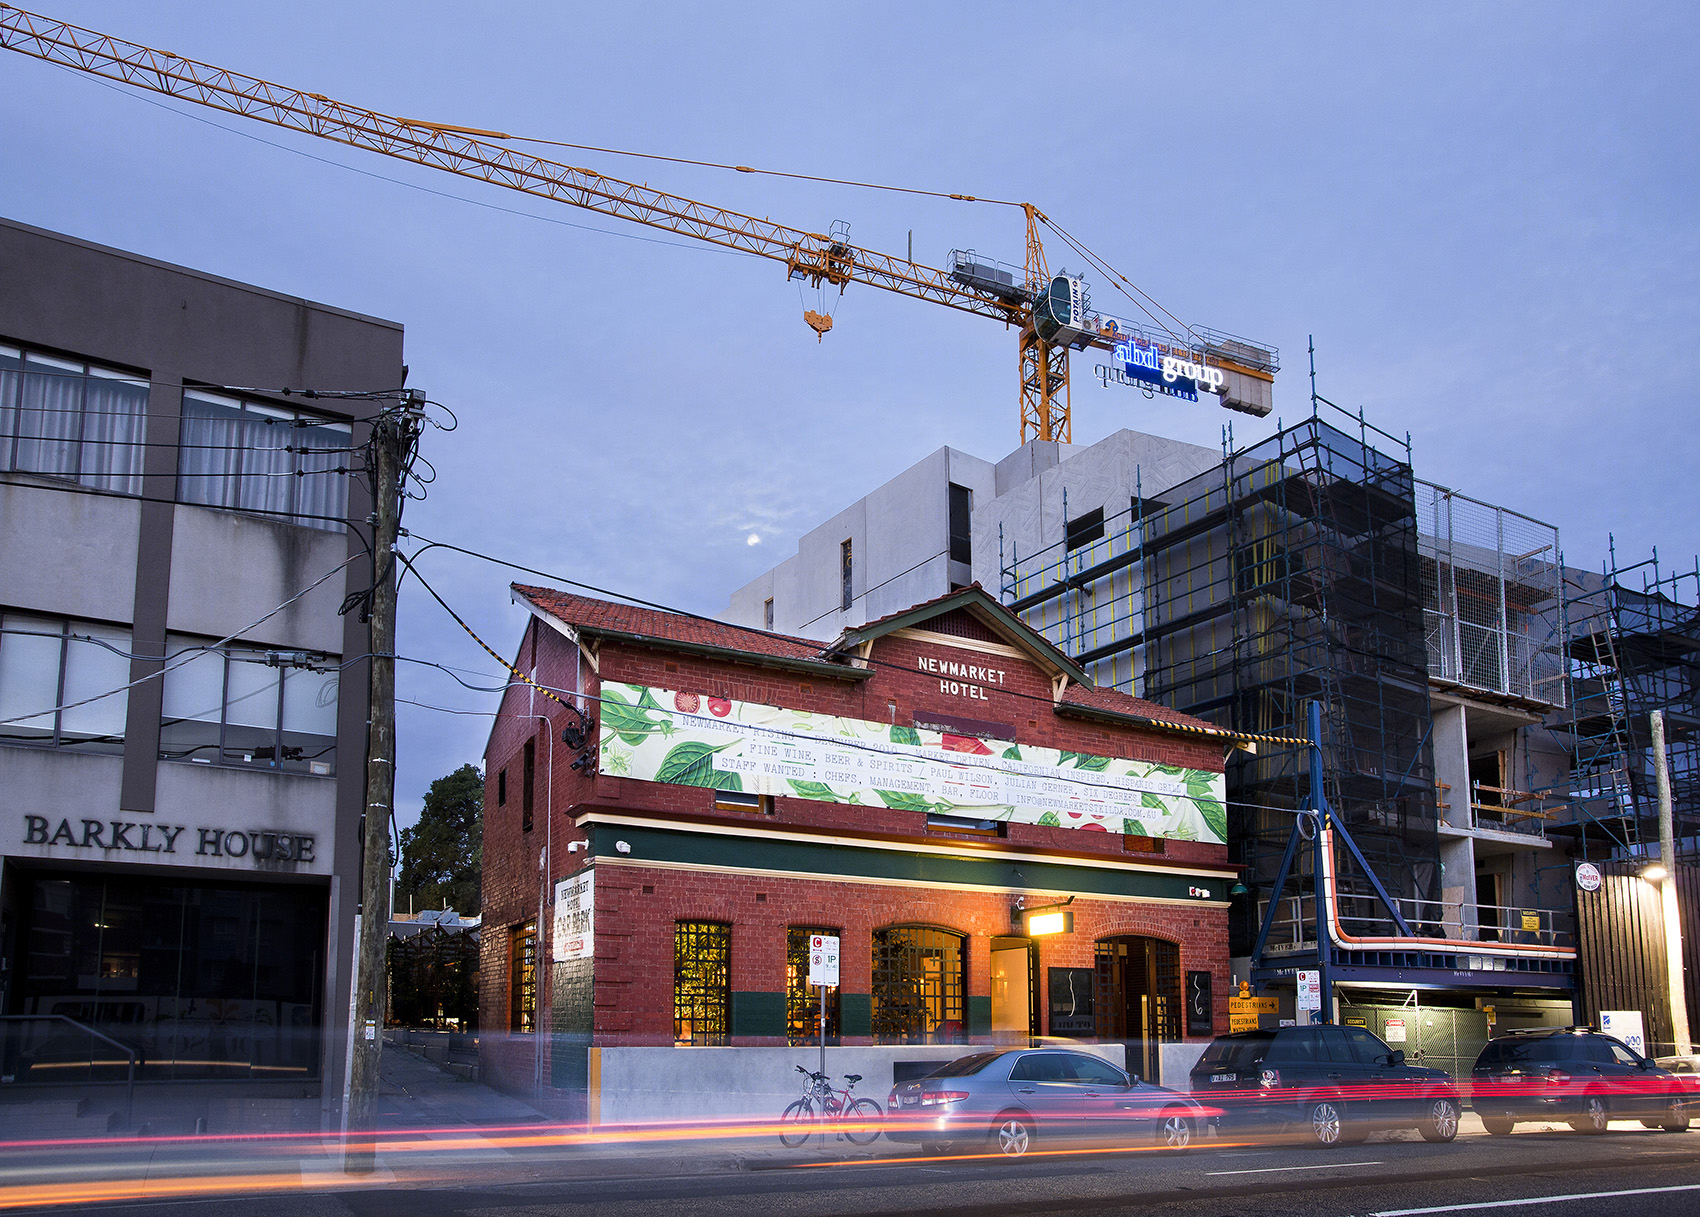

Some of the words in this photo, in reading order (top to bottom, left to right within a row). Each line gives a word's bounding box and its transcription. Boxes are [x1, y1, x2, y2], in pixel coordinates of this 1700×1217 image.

[1072, 288, 1080, 323] POTAIN
[1115, 339, 1160, 369] abd
[1162, 357, 1224, 392] group
[918, 656, 1006, 685] NEWMARKET
[940, 679, 989, 701] HOTEL
[682, 715, 745, 735] NEWMARKET
[753, 727, 795, 741] RISING
[814, 734, 866, 750] DECEMBER
[872, 742, 898, 754] 2010
[915, 748, 951, 763] MARKET
[1001, 760, 1061, 778] CALIFORNIAN
[1115, 776, 1154, 791] HISPANIC
[1157, 781, 1182, 794] GRILL
[750, 743, 778, 756] FINE
[784, 747, 816, 762] WINE,
[825, 753, 851, 766] BEER
[856, 758, 864, 768] &
[869, 759, 913, 774] SPIRITS
[919, 766, 925, 777] /
[930, 767, 954, 780] PAUL
[957, 771, 998, 785] WILSON,
[1004, 777, 1037, 790] JULIAN
[1041, 781, 1078, 796] GERNER,
[1083, 786, 1099, 798] SIX
[1103, 789, 1138, 802] DEGREES
[721, 757, 757, 771] STAFF
[763, 763, 805, 777] WANTED
[824, 770, 862, 785] CHEFS,
[869, 776, 935, 793] MANAGEMENT,
[941, 785, 963, 797] BAR,
[969, 789, 1000, 801] FLOOR
[1015, 794, 1158, 820] INFO@NEWMARKETSTKILDA.COM.AU
[23, 814, 185, 853] BARKLY
[195, 827, 317, 863] HOUSE
[1230, 1001, 1268, 1009] PEDESTRIANS
[1231, 1017, 1258, 1026] PEDESTRIANS
